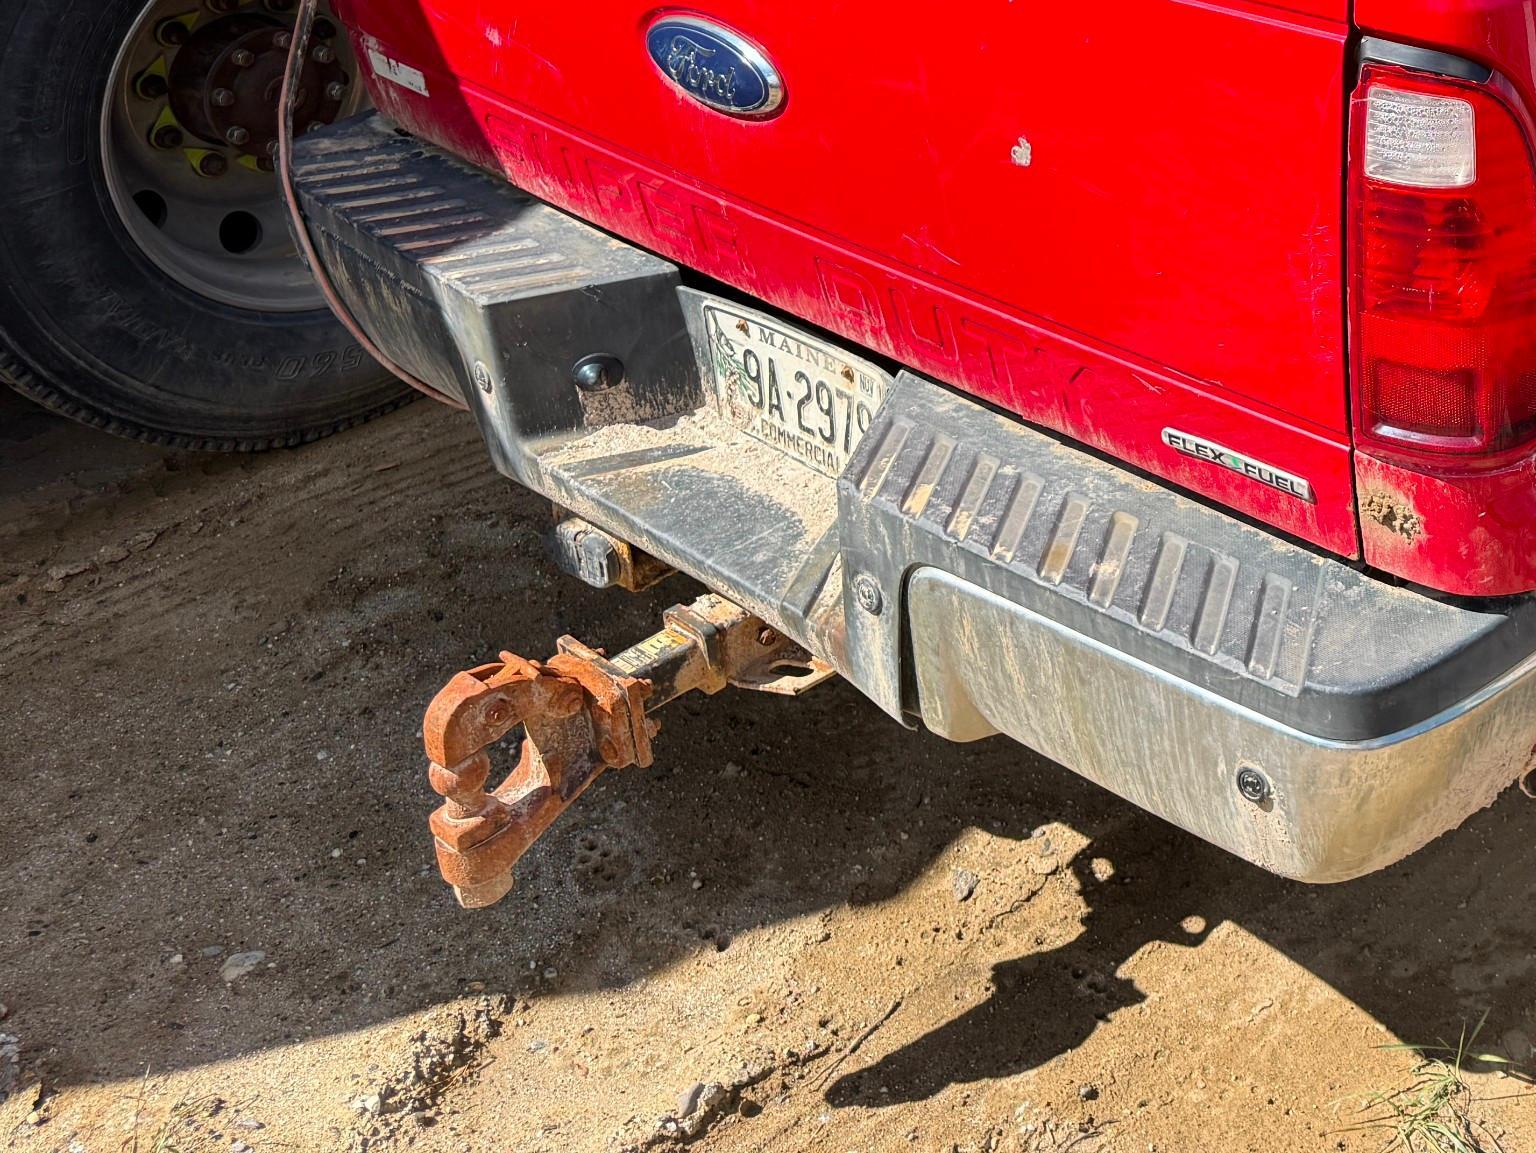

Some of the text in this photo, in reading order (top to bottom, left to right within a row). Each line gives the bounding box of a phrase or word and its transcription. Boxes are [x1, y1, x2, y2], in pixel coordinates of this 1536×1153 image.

[667, 35, 735, 99] Ford
[758, 326, 837, 375] MAINE
[1167, 432, 1304, 496] FLEX FUEL
